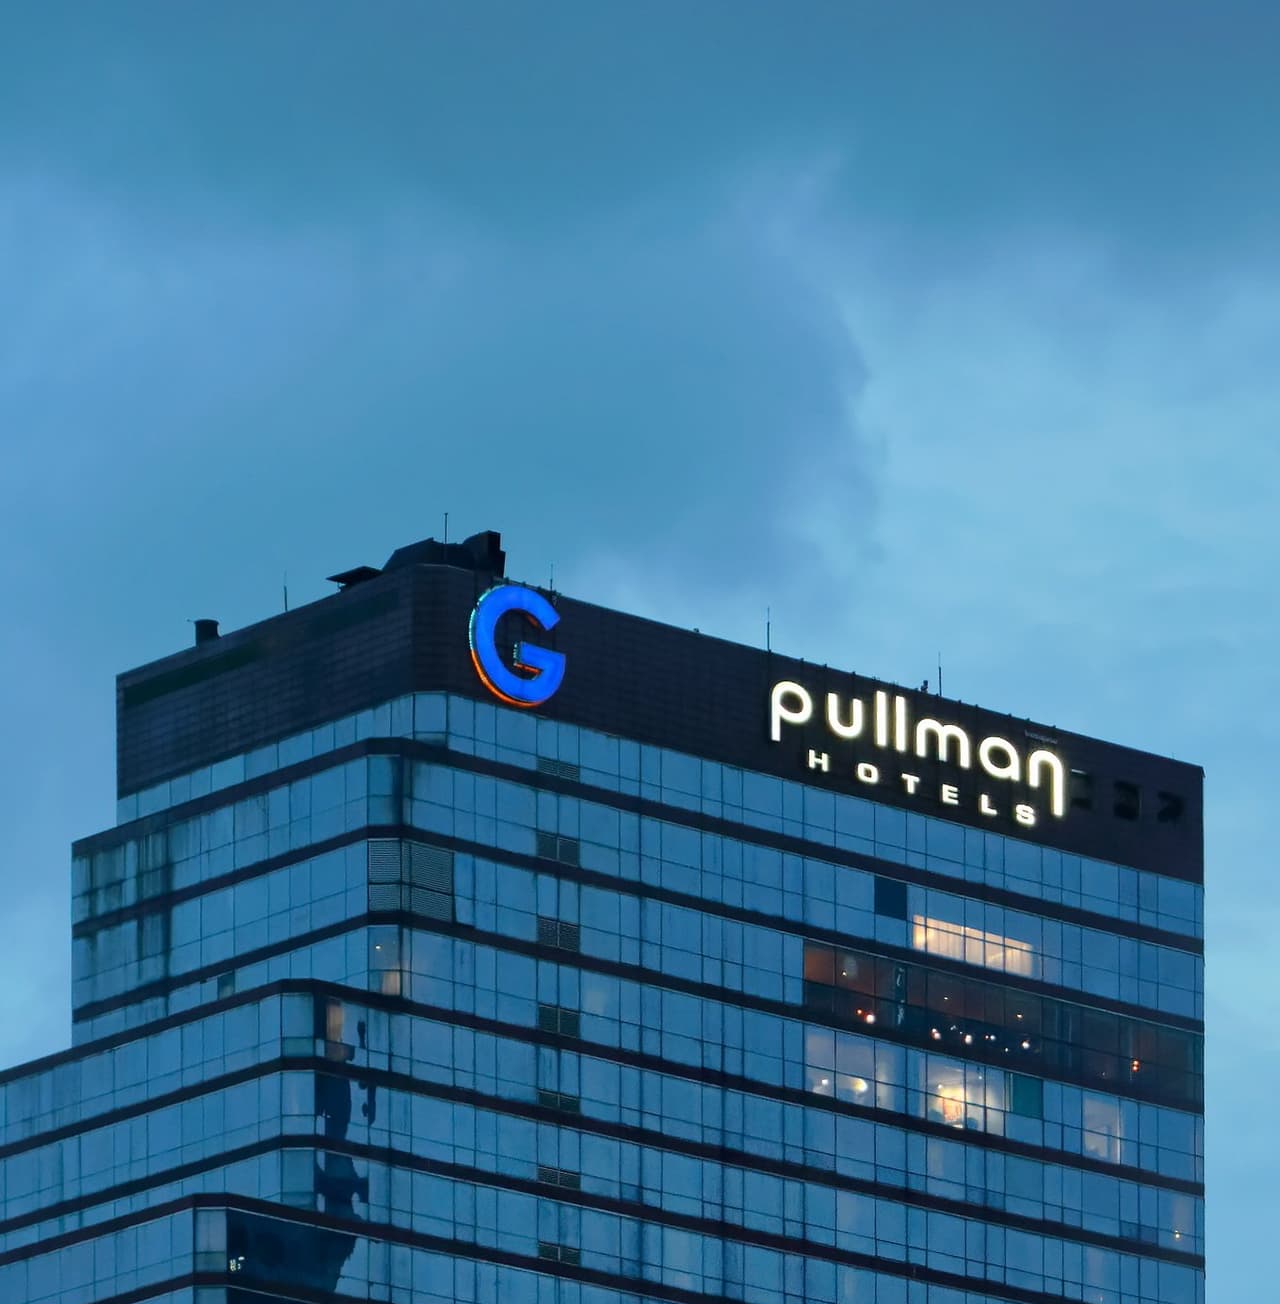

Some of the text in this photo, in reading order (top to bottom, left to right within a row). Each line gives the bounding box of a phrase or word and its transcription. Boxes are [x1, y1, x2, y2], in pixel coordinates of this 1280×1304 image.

[469, 585, 566, 707] G
[770, 680, 1066, 818] pullman
[808, 749, 1037, 826] HOTELS
